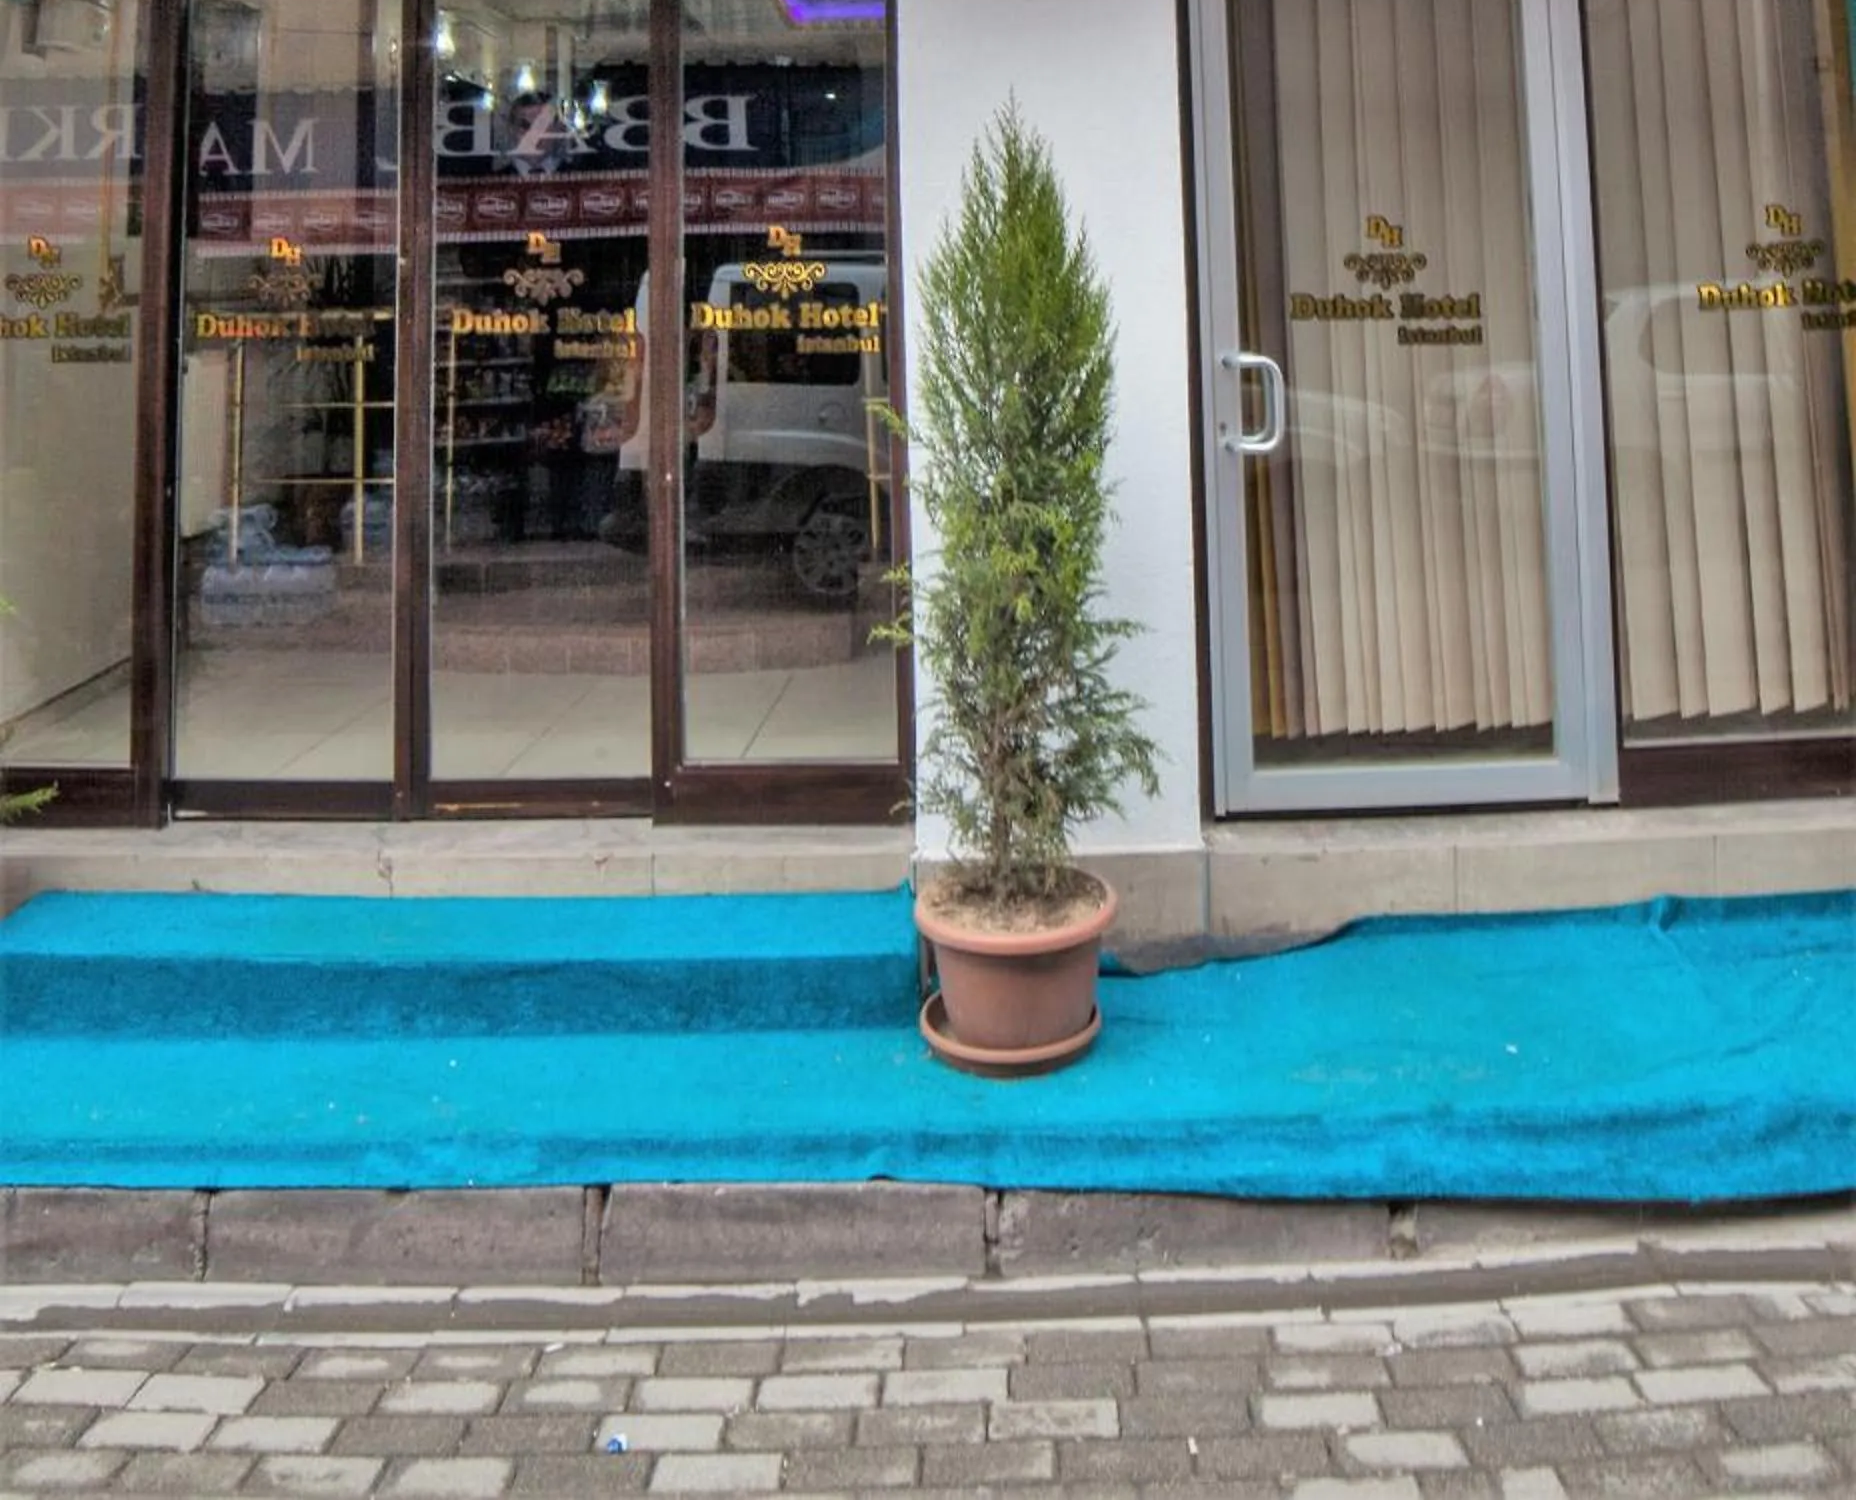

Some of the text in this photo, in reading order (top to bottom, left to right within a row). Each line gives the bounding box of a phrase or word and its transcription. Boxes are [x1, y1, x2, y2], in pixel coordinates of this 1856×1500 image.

[1291, 292, 1480, 319] Duhok Hotel
[1697, 282, 1798, 310] Duhok
[453, 307, 636, 334] Duhok Hotel
[691, 301, 879, 329] Duhok Hotel
